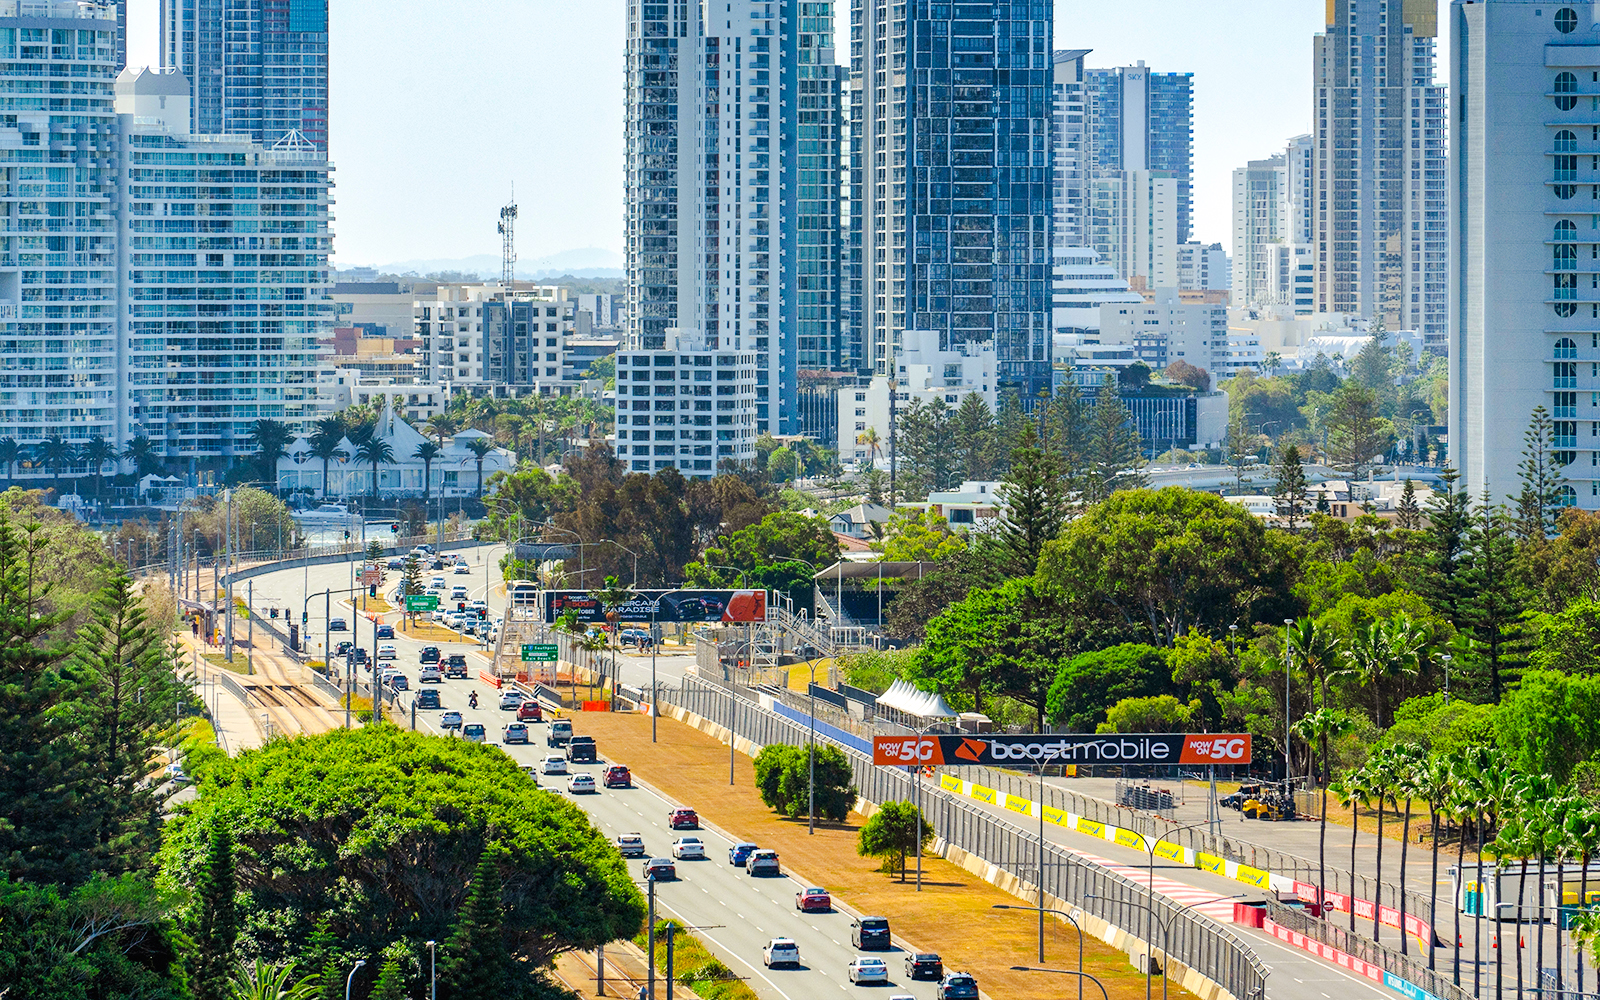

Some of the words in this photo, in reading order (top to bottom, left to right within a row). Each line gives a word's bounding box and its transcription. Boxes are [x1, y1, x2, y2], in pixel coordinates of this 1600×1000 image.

[899, 741, 935, 760] 5G
[991, 738, 1170, 759] boostmobile
[1210, 739, 1245, 759] 5G
